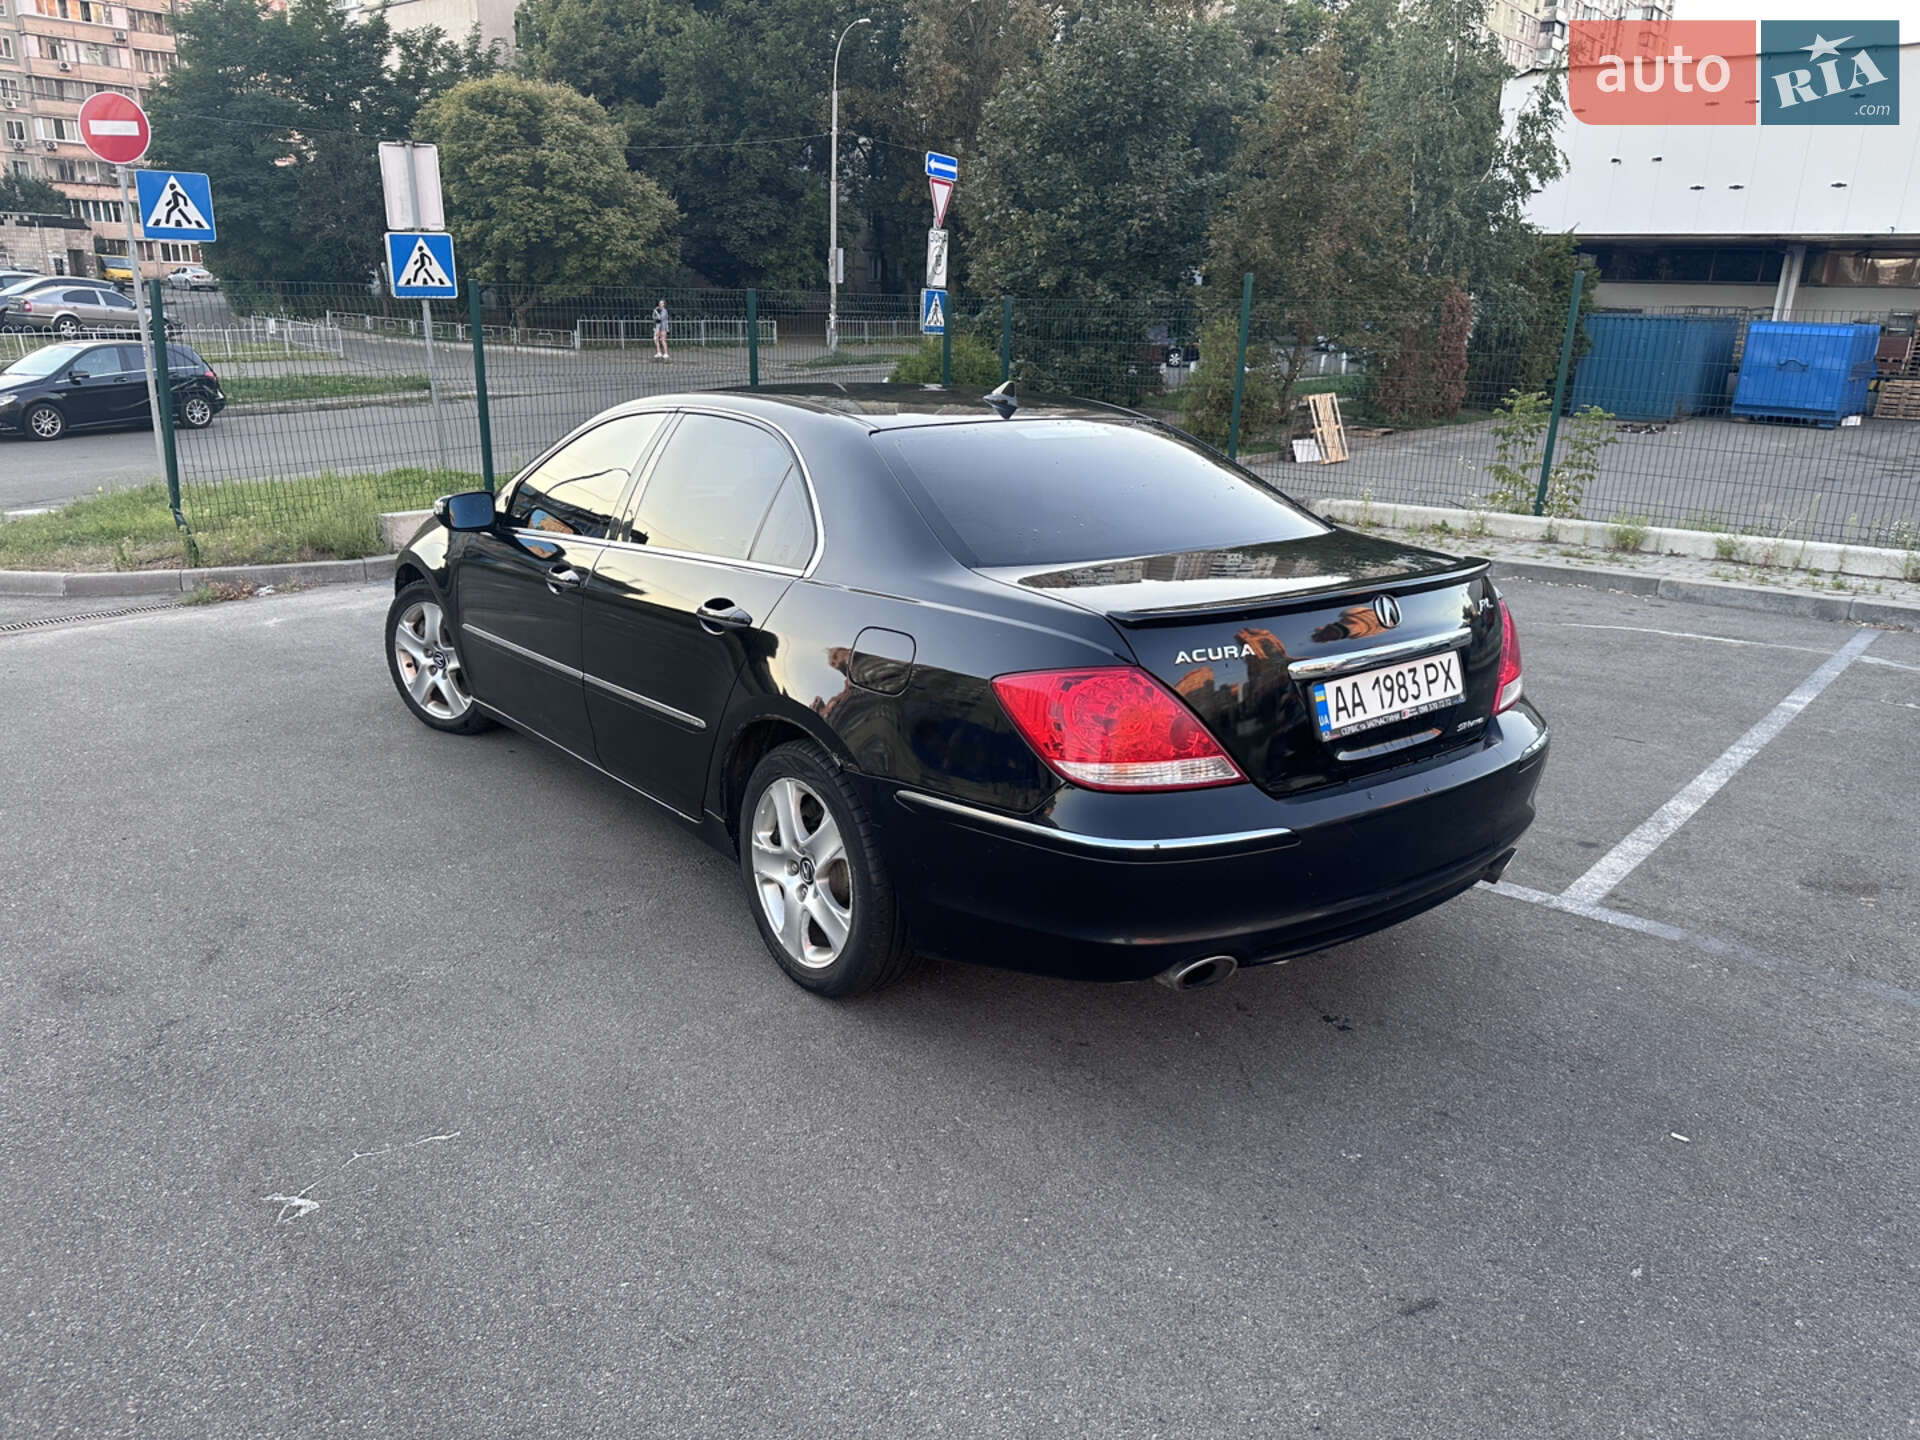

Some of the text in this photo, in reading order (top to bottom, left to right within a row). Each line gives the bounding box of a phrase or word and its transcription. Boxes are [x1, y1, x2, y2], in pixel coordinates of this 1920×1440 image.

[1174, 643, 1256, 665] ACURA
[1335, 657, 1457, 722] AA 1983 PX
[1318, 714, 1330, 727] UA
